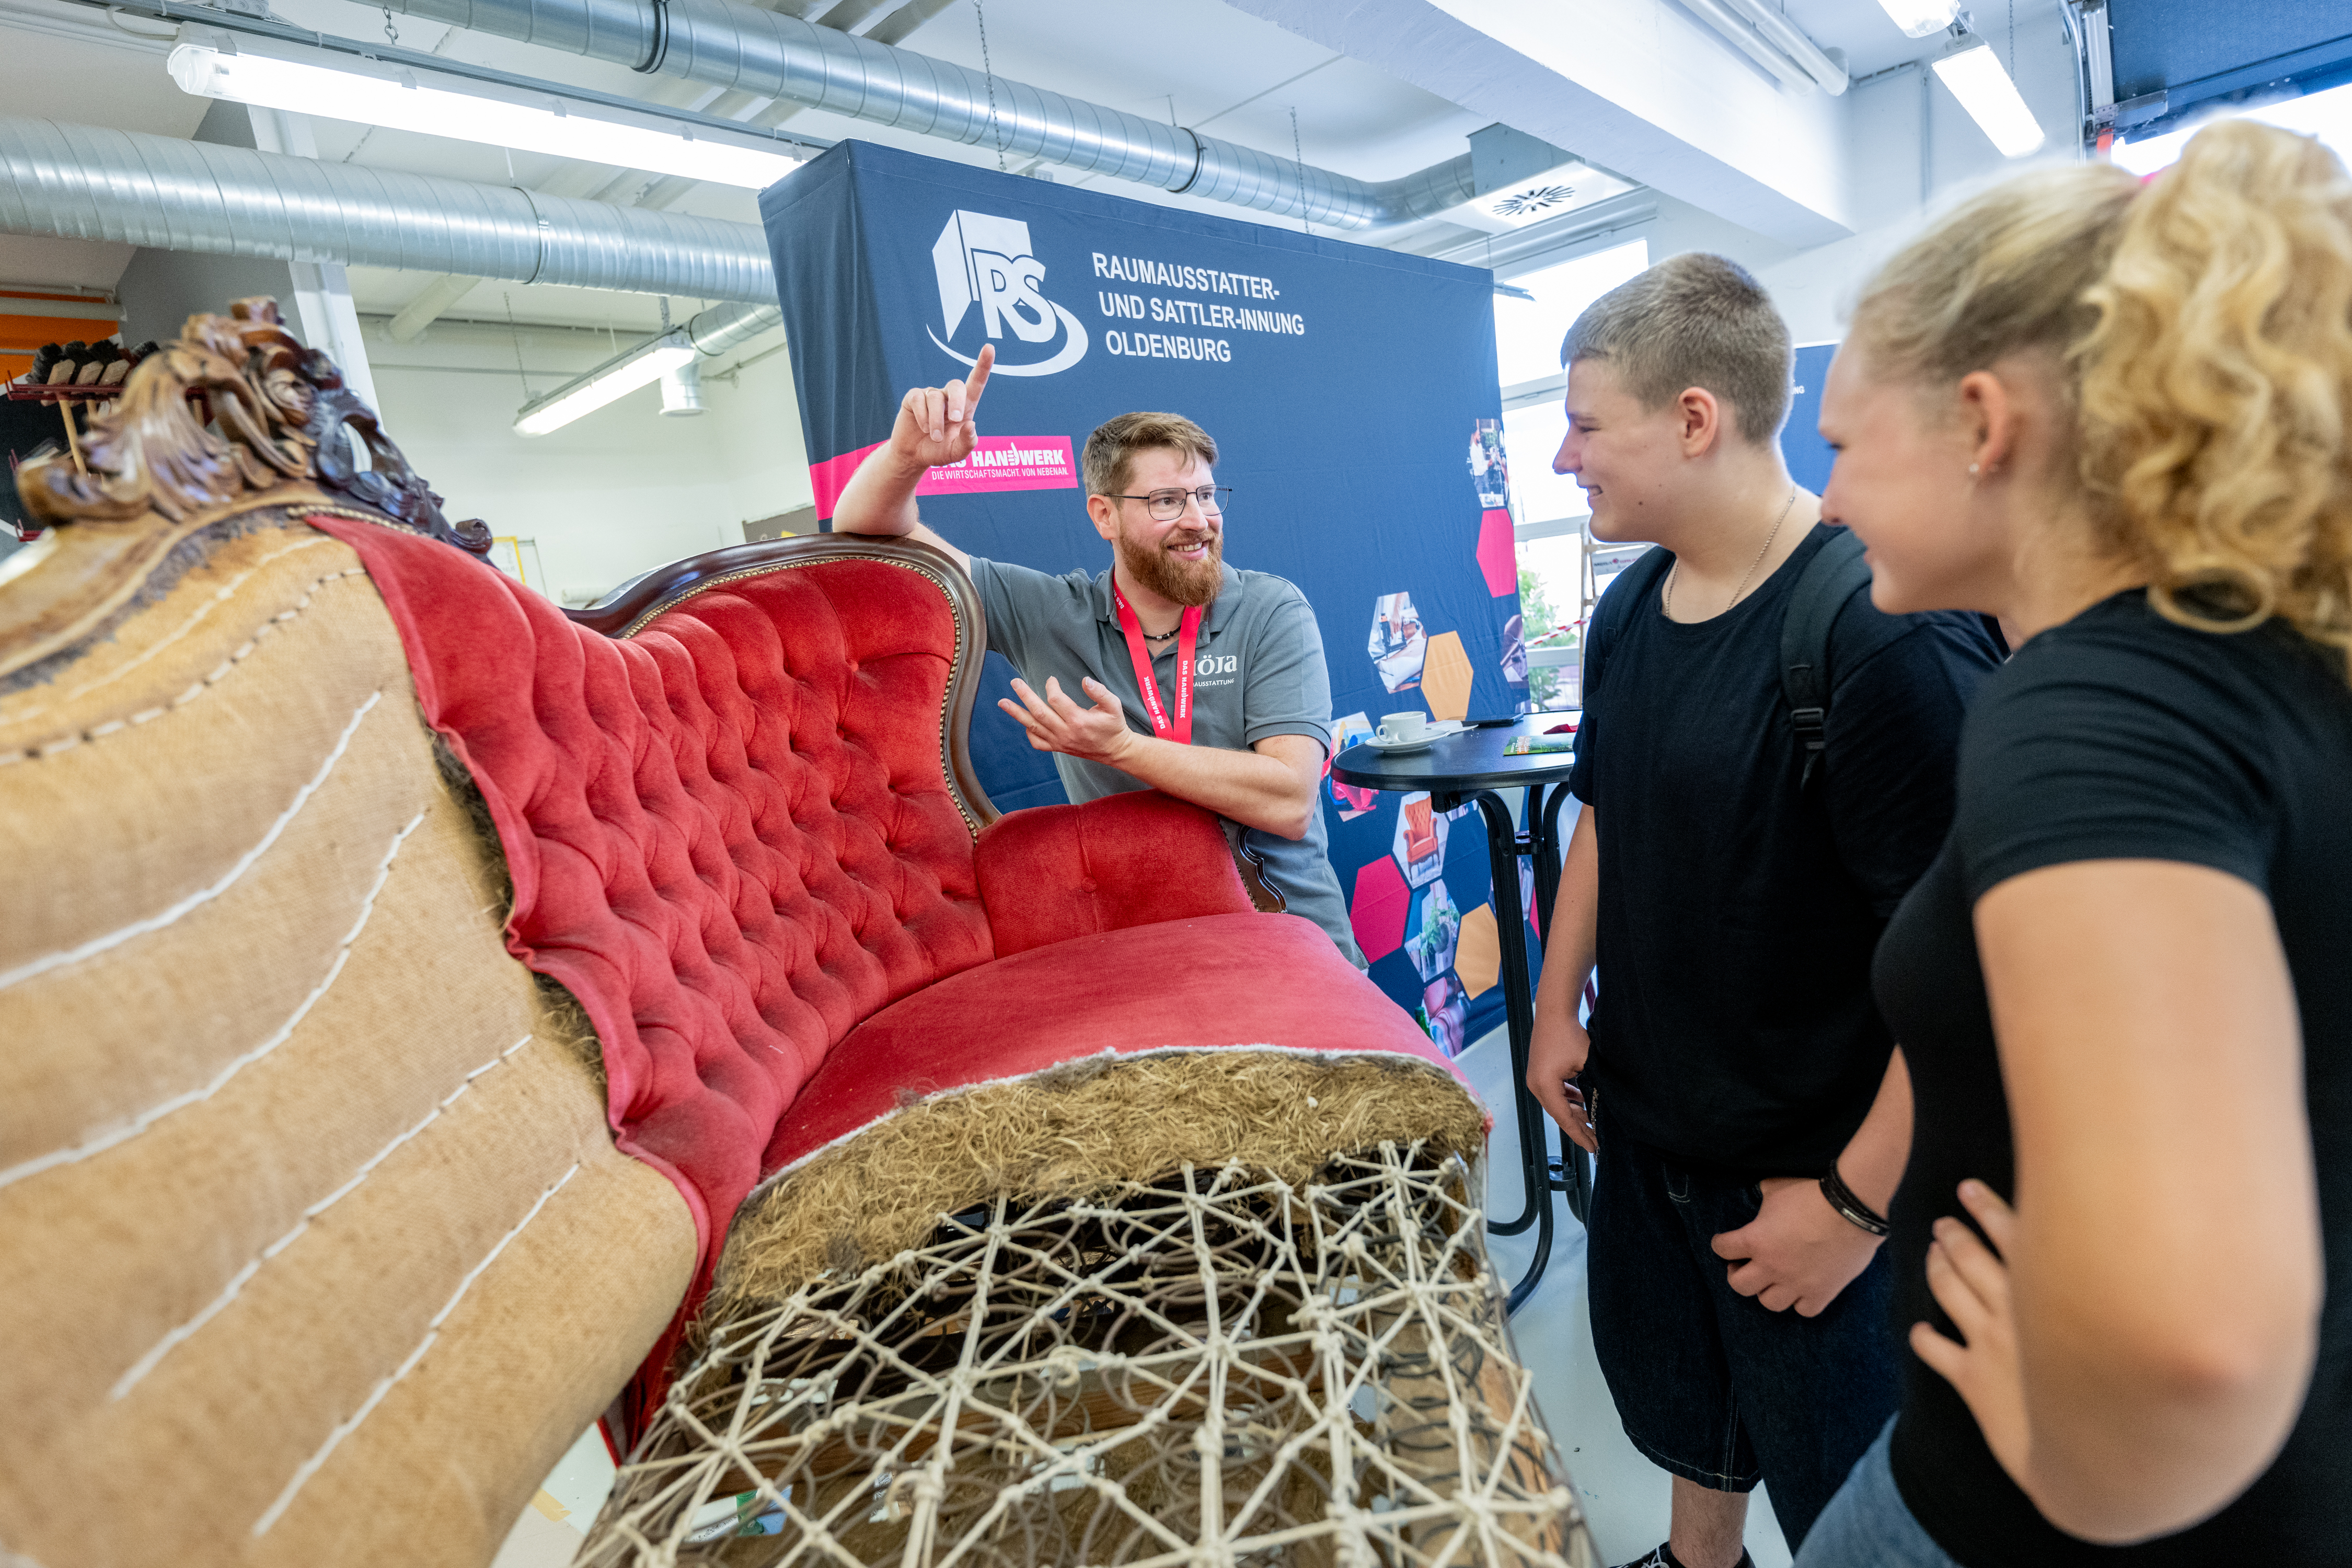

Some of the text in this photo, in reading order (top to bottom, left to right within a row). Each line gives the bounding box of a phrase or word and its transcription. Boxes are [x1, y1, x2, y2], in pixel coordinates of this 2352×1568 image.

[1092, 252, 1279, 300] RAUMAUSSTATTER-
[1099, 292, 1305, 335] UND SATTLER-INNUNG
[1106, 330, 1231, 362] OLDENBURG
[932, 467, 1069, 480] DIE WIRTSCHAFTSMACHT. VON NEBENAN.
[1157, 715, 1166, 729] DAS
